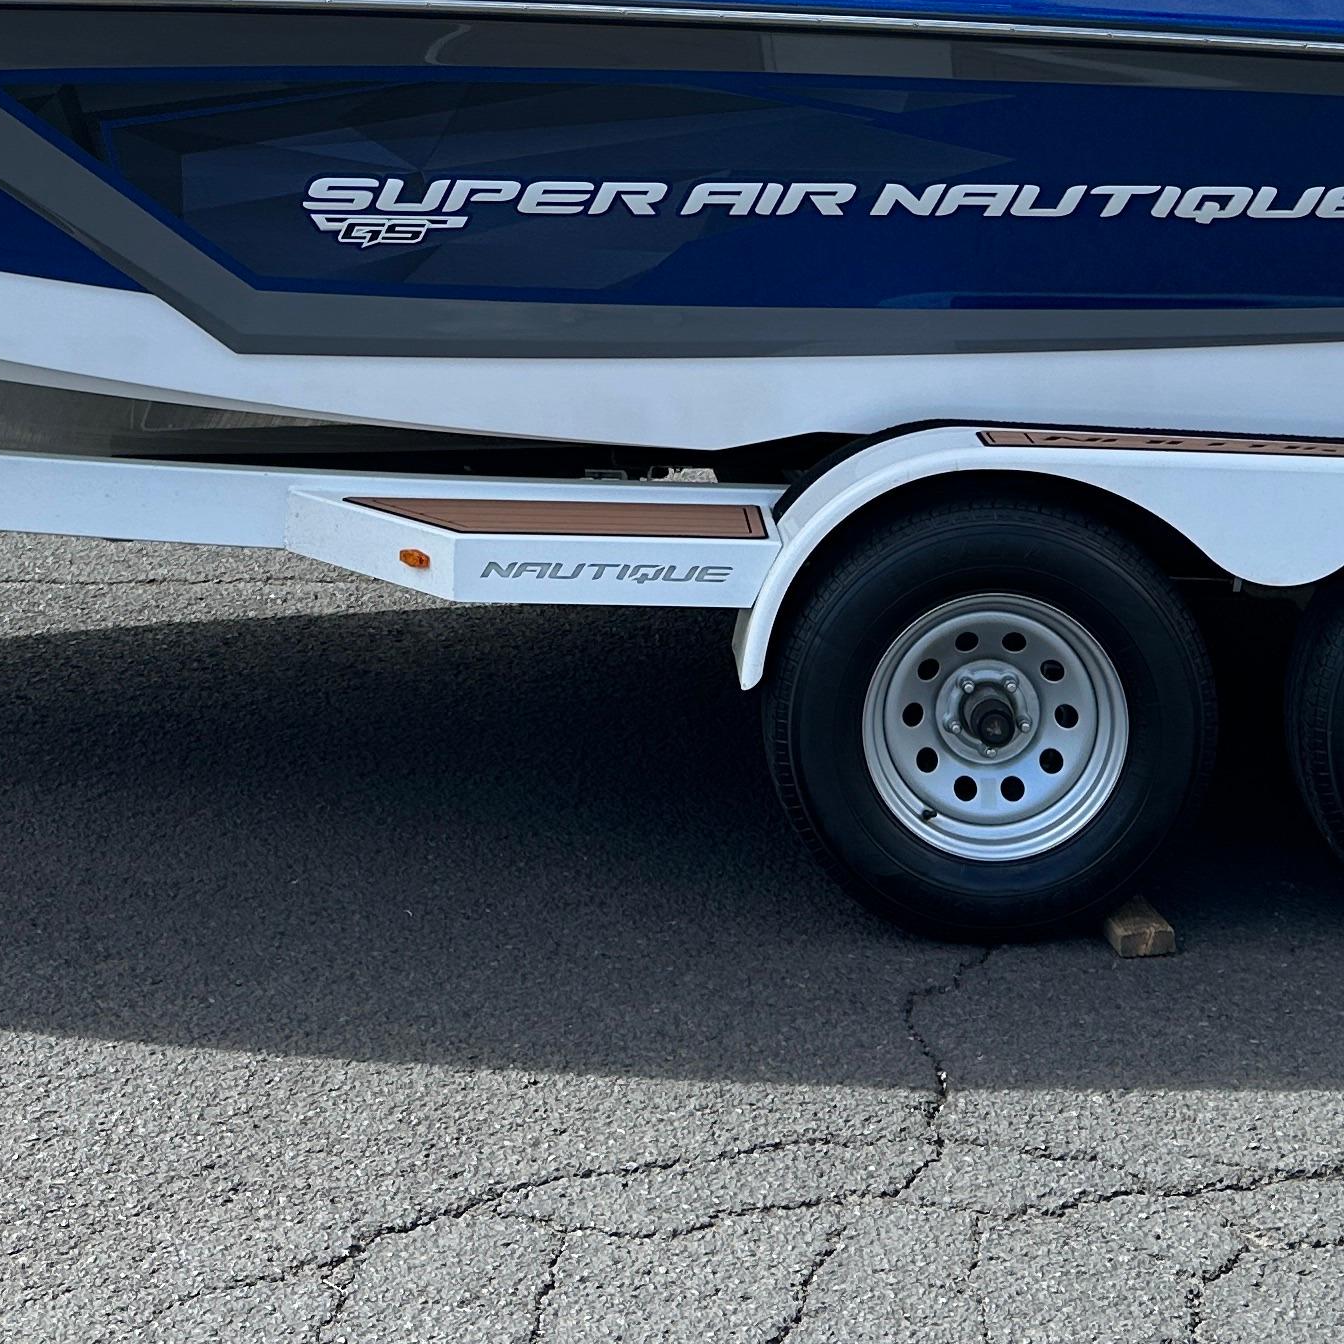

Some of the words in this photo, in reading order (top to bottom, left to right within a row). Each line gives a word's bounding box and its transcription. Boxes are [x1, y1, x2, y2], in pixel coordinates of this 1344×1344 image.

[302, 177, 668, 215] SUPER
[680, 182, 857, 216] AIR
[479, 560, 735, 585] NAUTIQUE
